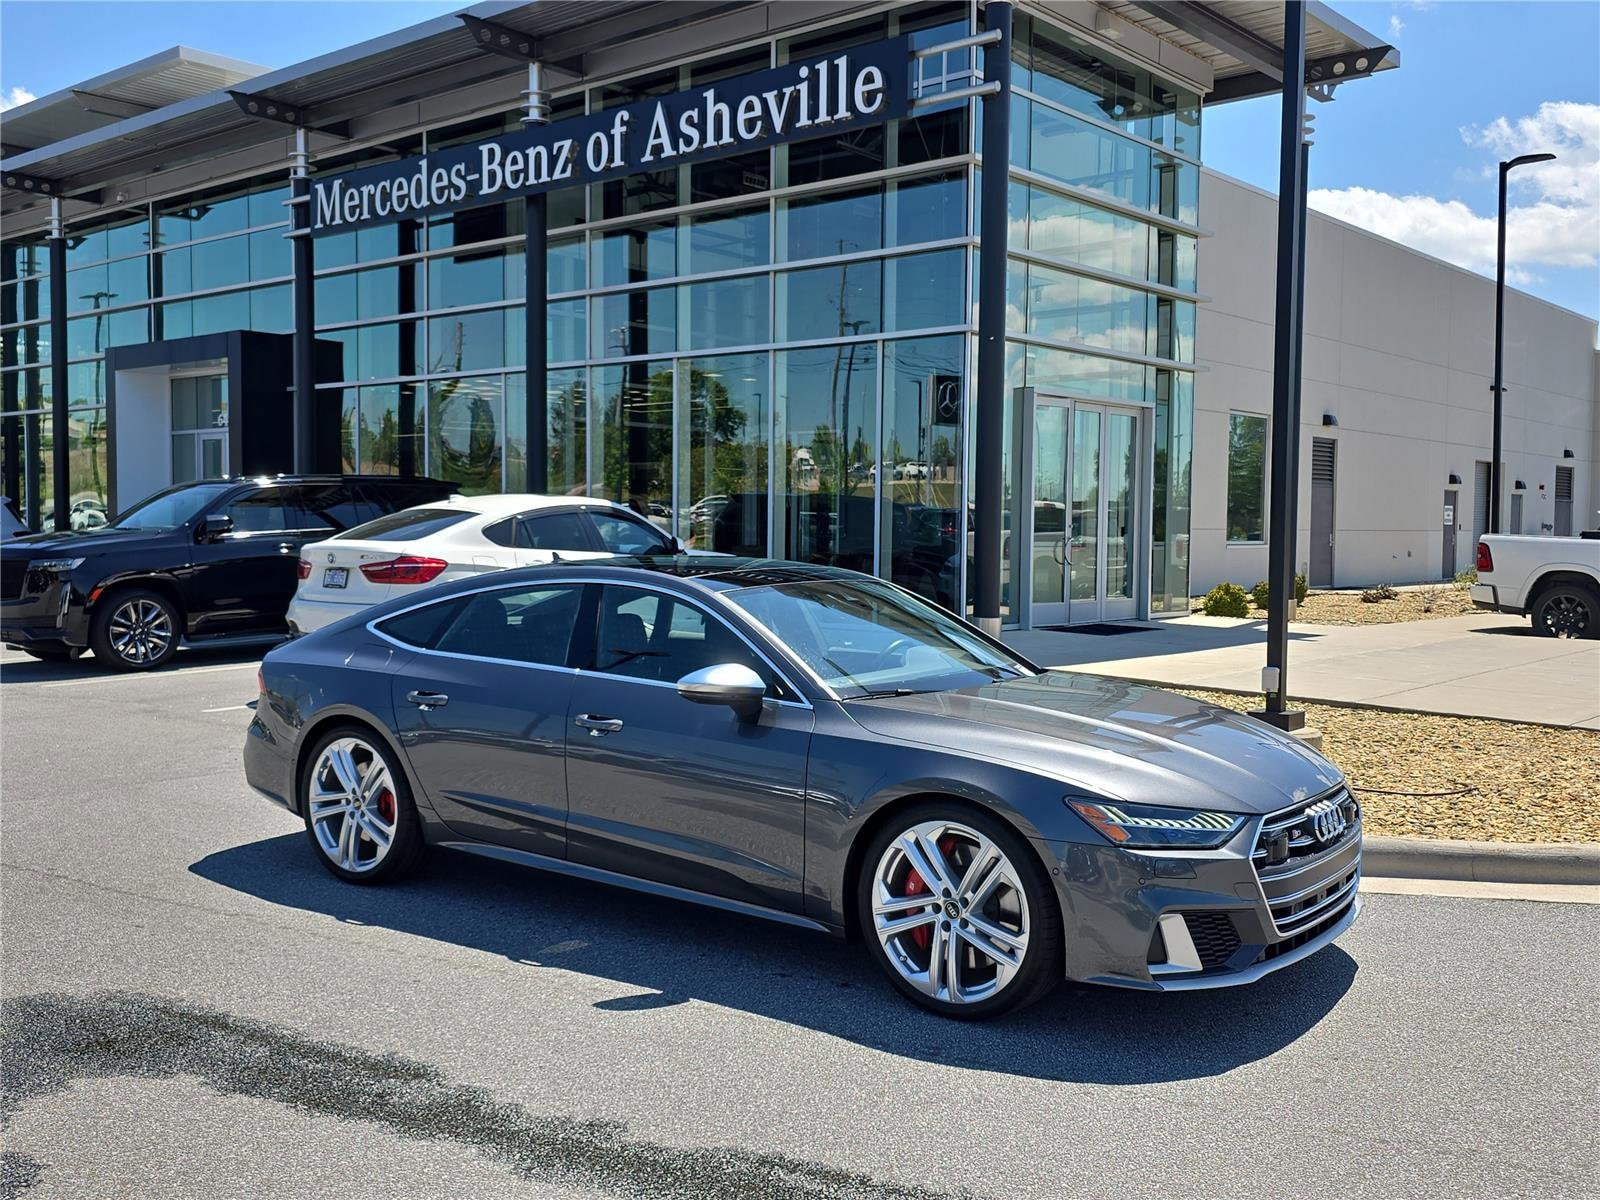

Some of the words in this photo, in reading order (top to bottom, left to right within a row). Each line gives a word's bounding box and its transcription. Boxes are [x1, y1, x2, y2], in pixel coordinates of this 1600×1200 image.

[314, 139, 573, 229] Mercedes-Benz
[586, 110, 630, 173] of
[641, 55, 883, 162] Asheville
